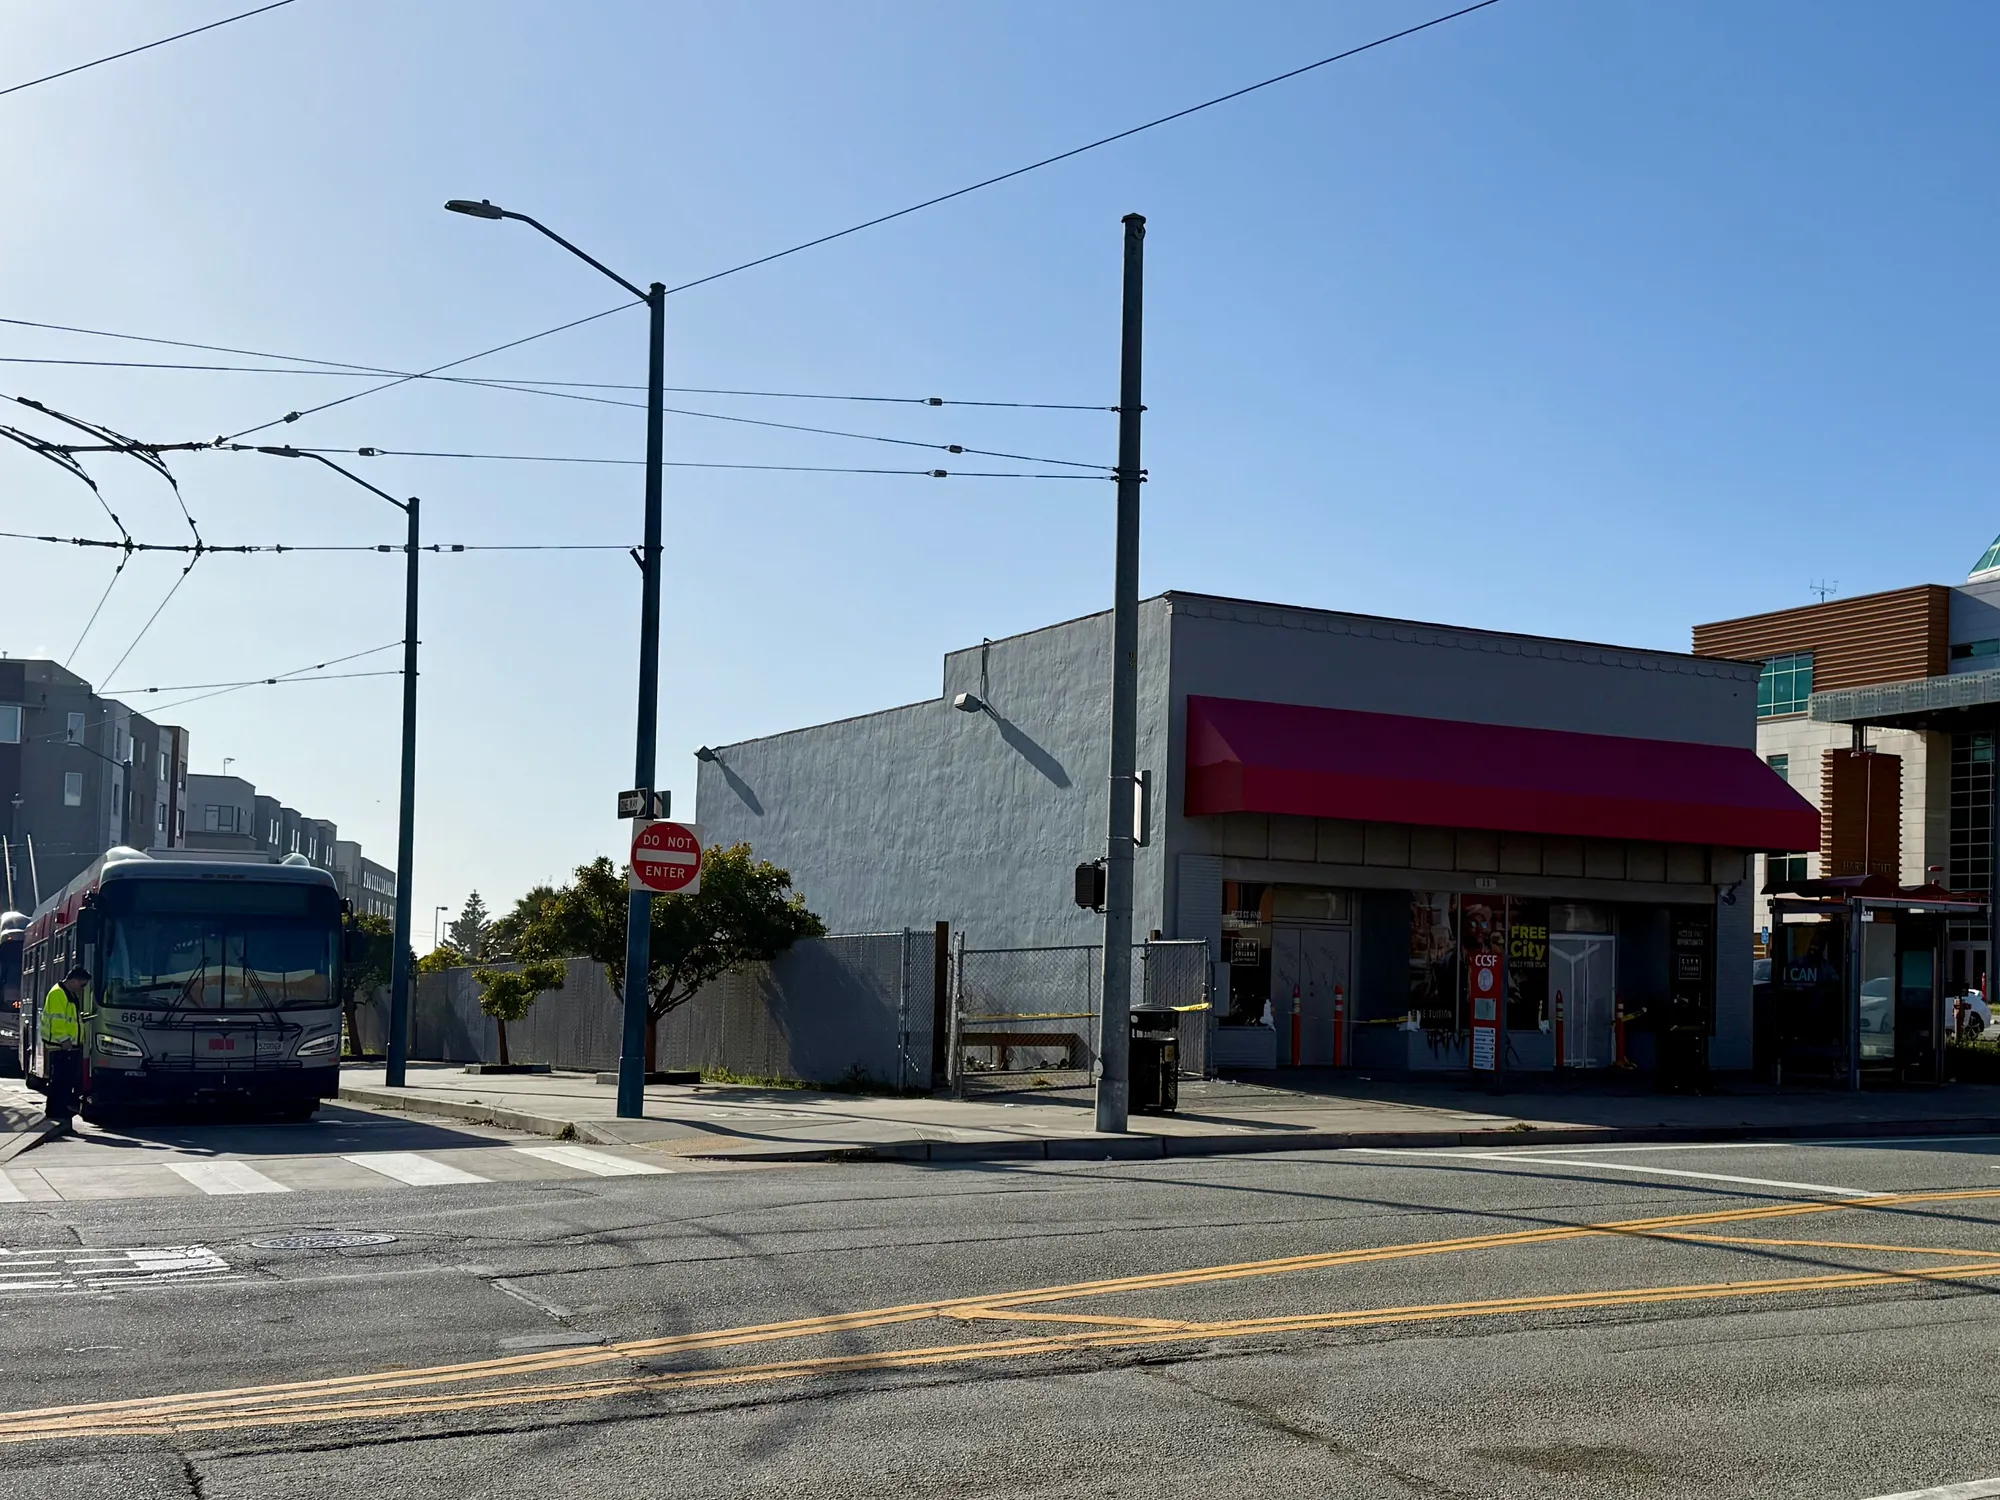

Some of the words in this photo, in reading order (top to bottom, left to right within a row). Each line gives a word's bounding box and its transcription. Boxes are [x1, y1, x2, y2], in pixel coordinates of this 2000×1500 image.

[643, 834, 660, 846] DO
[667, 836, 692, 849] NOT
[645, 865, 685, 879] ENTER
[1511, 925, 1547, 939] FREE
[1510, 939, 1546, 961] City
[1475, 954, 1497, 967] CCSF
[1789, 967, 1818, 982] CAN
[121, 1012, 152, 1023] 6644
[1428, 1009, 1452, 1019] TUITION
